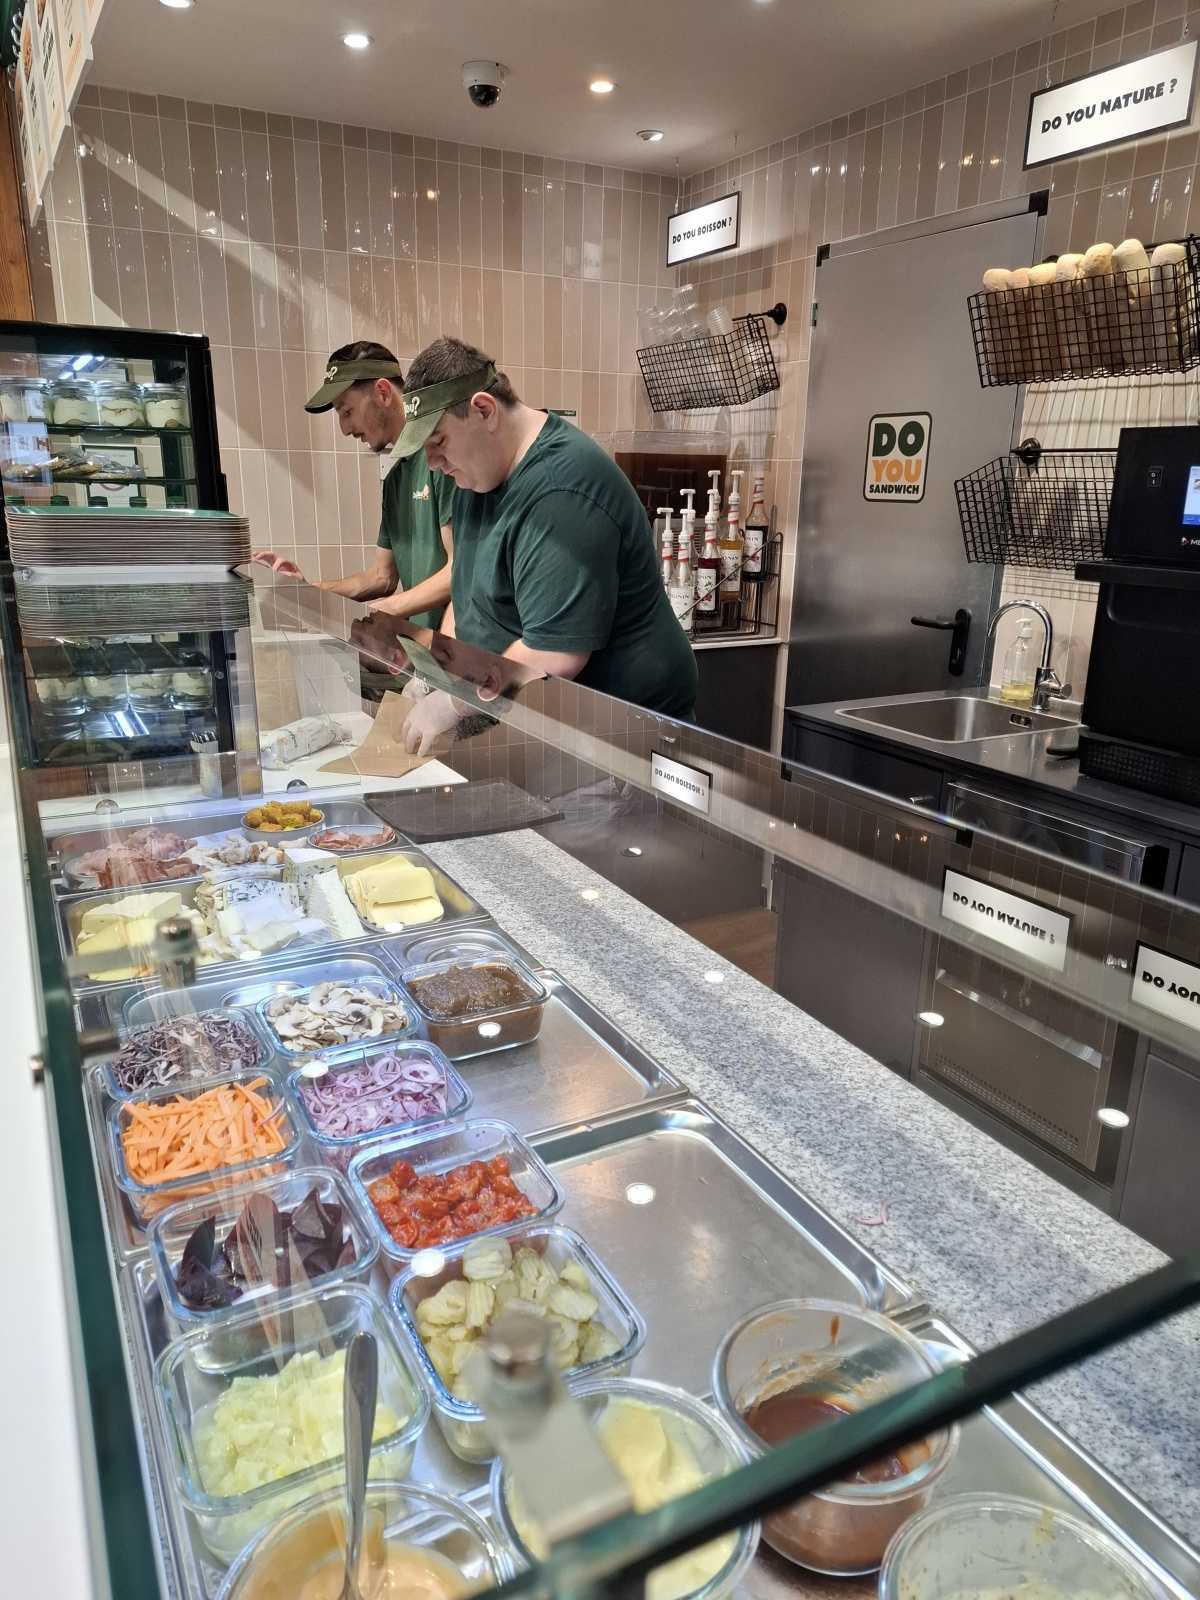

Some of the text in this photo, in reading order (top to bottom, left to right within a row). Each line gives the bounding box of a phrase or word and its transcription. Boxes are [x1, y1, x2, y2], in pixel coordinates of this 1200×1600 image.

[1041, 78, 1178, 133] DO YOU NATURE ?
[672, 234, 682, 244] DO
[683, 228, 696, 240] YOU
[697, 218, 727, 236] BOISSON
[872, 421, 925, 457] DO
[871, 459, 922, 482] YOU
[869, 484, 920, 494] SANDWICH
